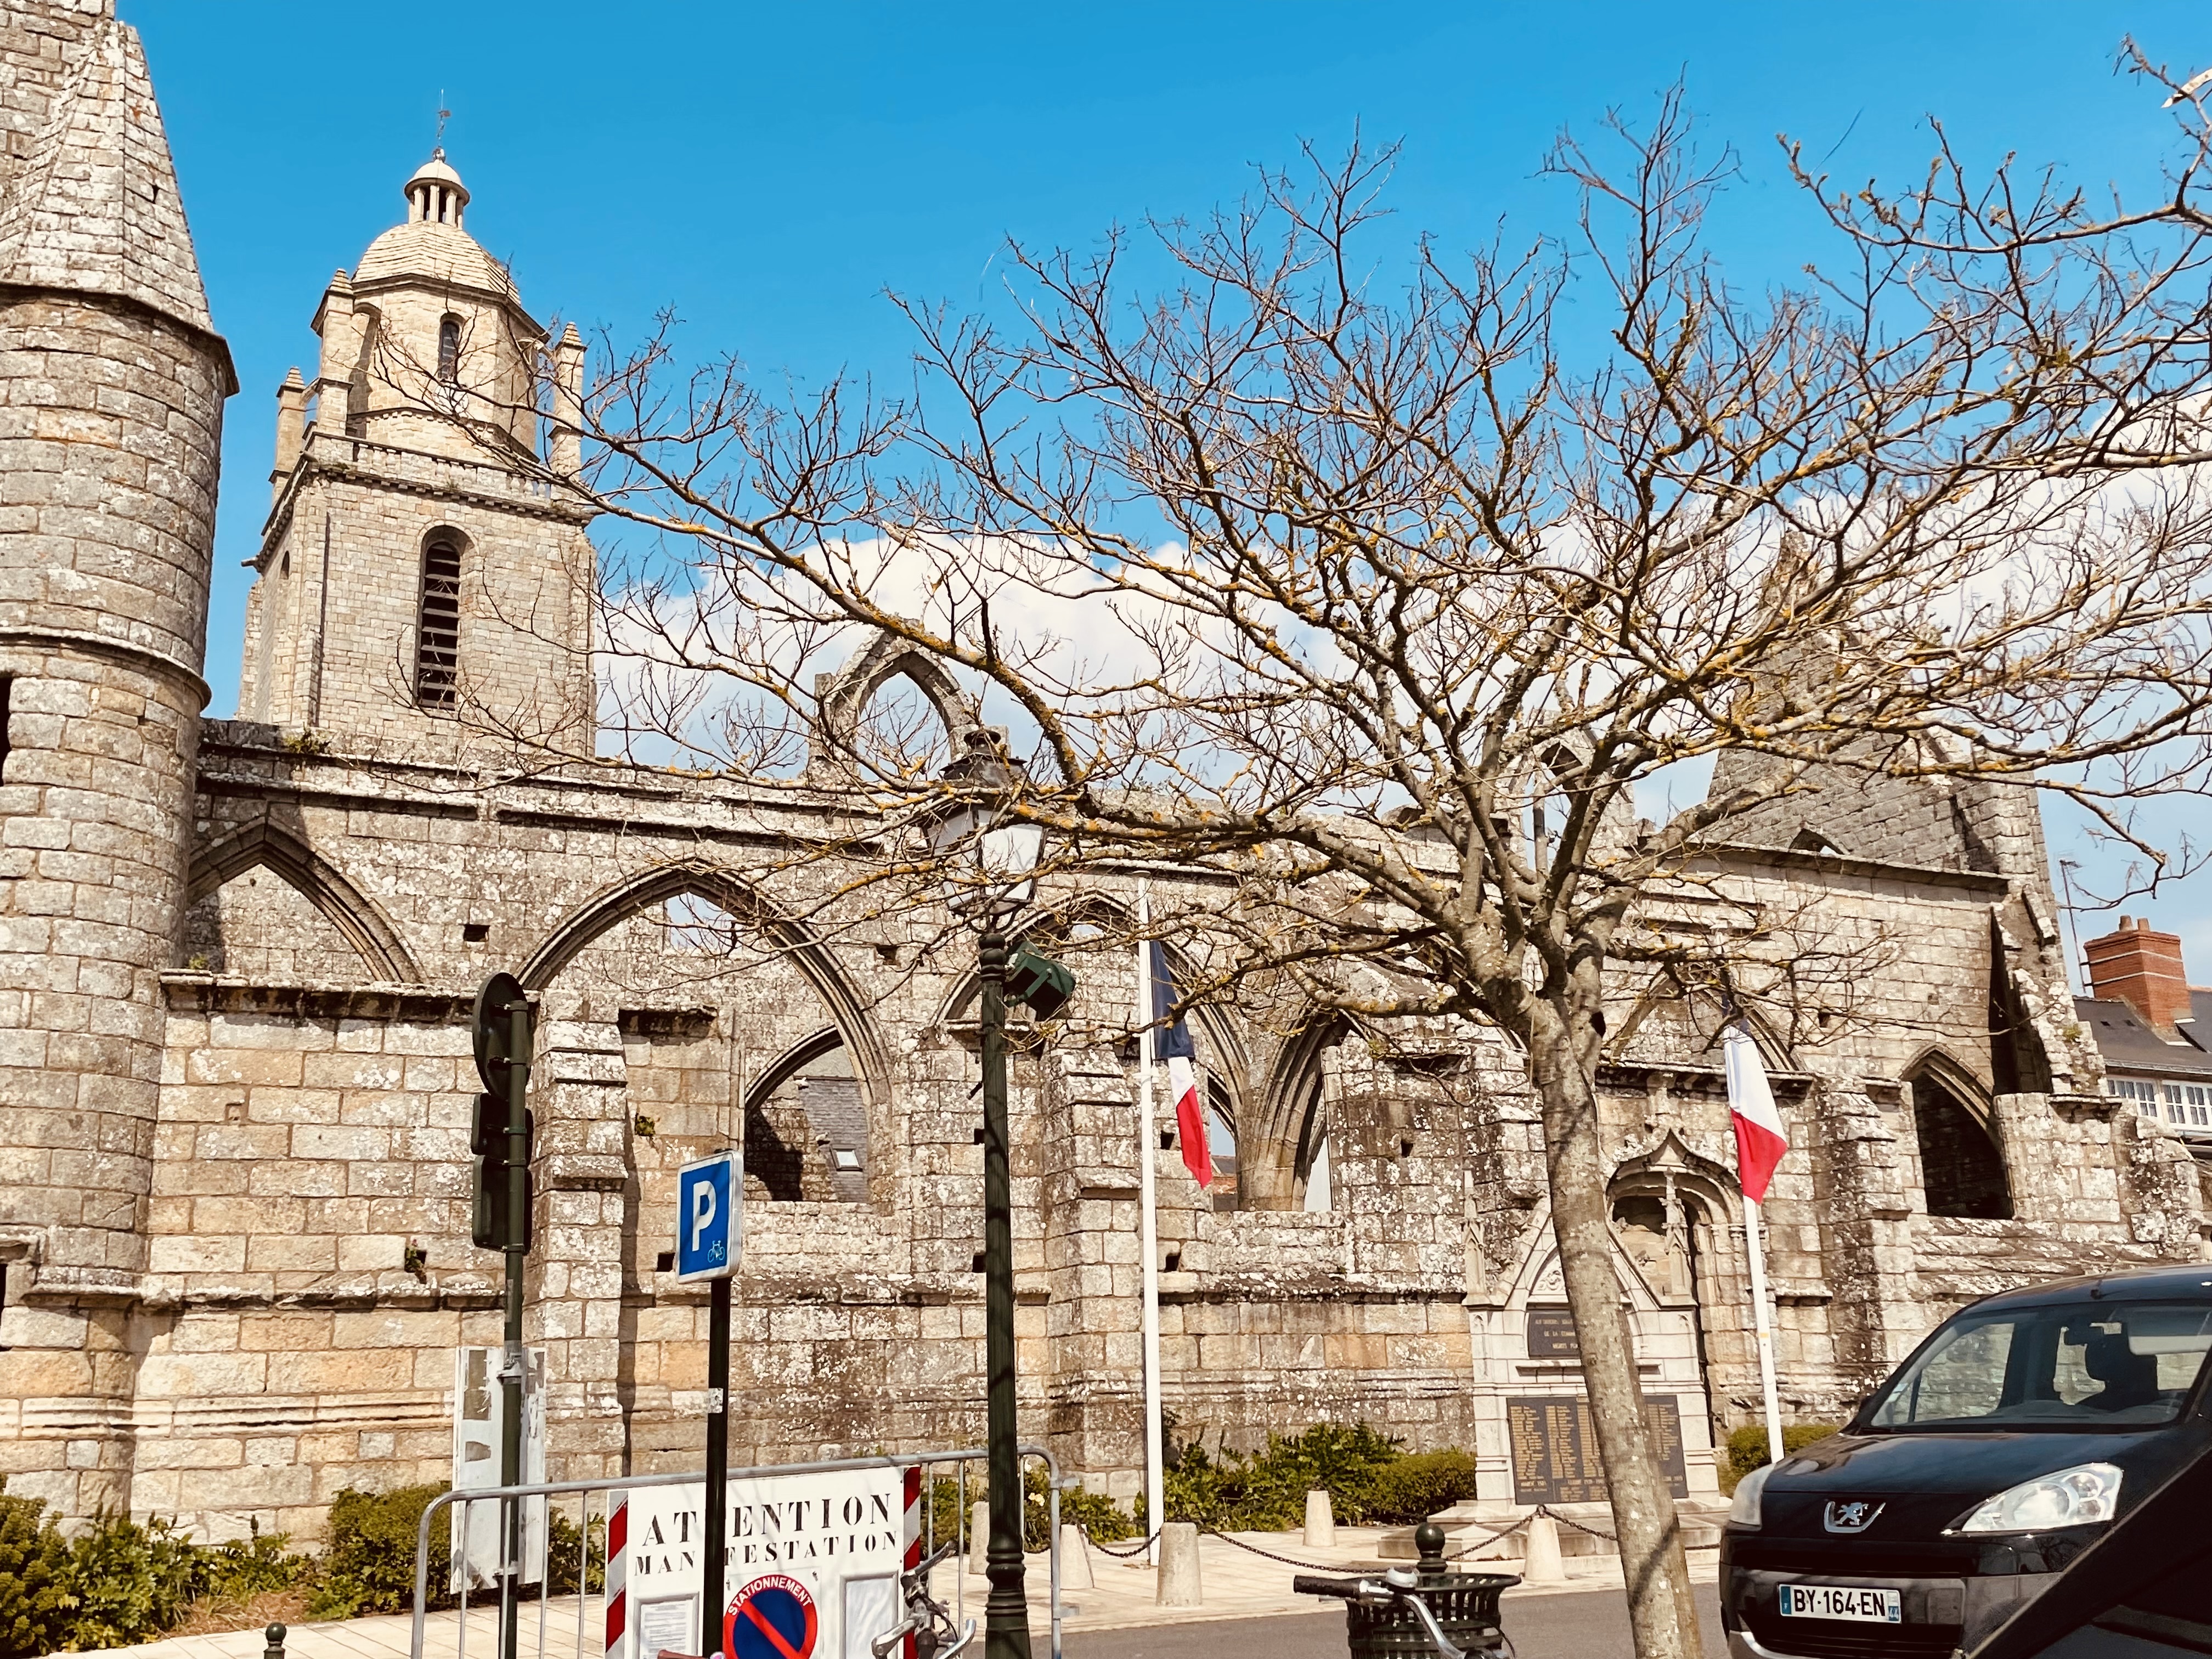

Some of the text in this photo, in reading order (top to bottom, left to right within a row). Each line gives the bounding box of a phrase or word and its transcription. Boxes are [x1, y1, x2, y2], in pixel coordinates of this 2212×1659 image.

[692, 1180, 716, 1251] P
[642, 1493, 891, 1547] ATENTION
[634, 1531, 897, 1576] MANFESTATION
[728, 1576, 812, 1616] STATIONNEMENT
[1793, 1589, 1886, 1616] BY-164-EN
